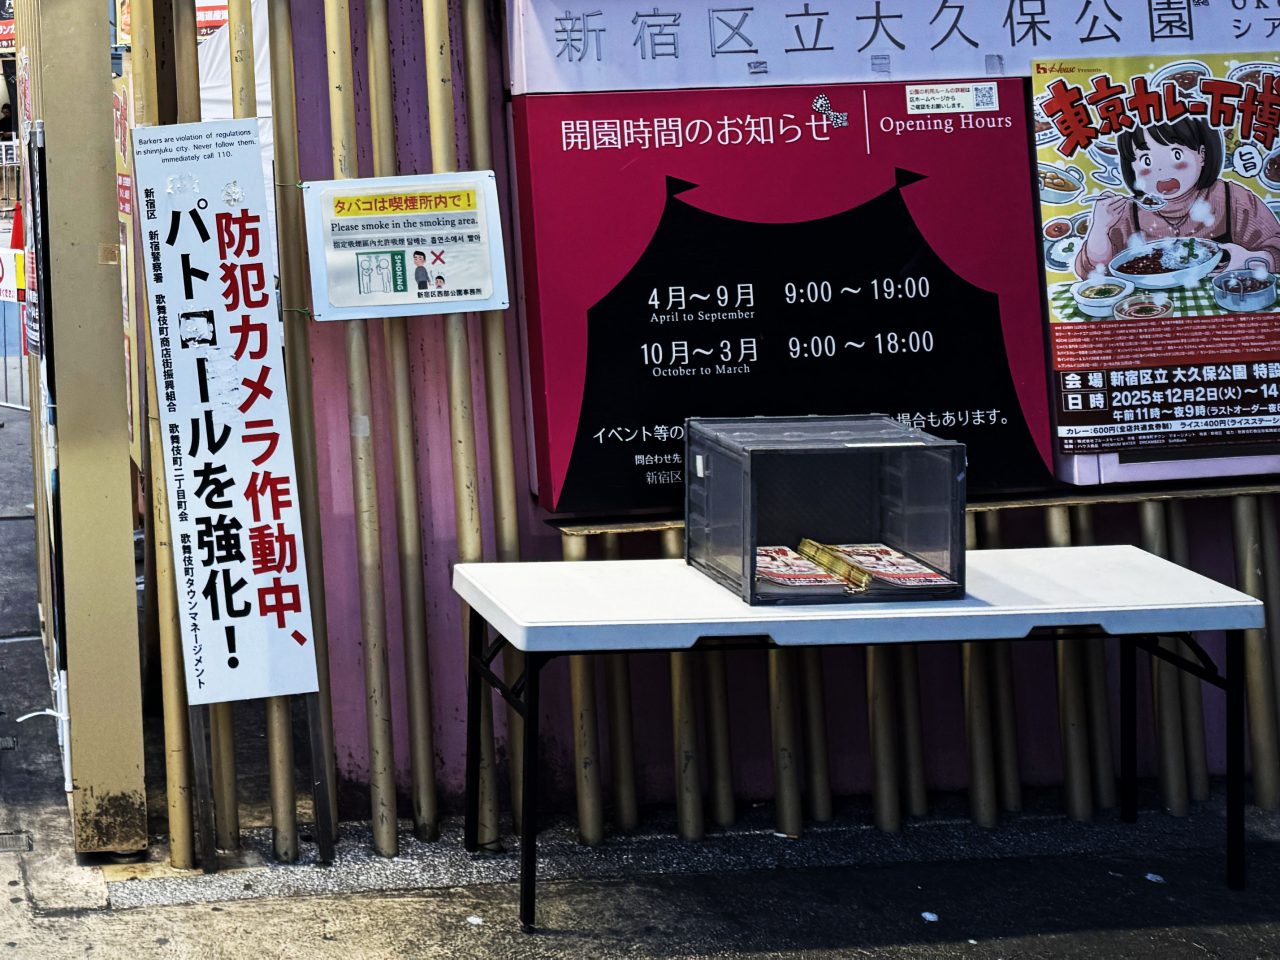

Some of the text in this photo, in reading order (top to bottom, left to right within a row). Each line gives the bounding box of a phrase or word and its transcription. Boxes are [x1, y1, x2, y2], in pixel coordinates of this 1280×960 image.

[880, 113, 1012, 135] Opening Hours
[1038, 73, 1280, 158] 東京カレー万博
[176, 134, 203, 142] violation
[216, 129, 252, 138] regulations
[561, 113, 832, 152] 開園時間のお知らせ
[162, 155, 200, 164] immediately
[144, 188, 157, 220] 新宿区
[334, 193, 472, 214] タバコは喫煙所内で！
[331, 217, 479, 232] Please smoke in the smoking area.
[148, 230, 163, 284] 新宿警察署
[394, 254, 403, 291] SMOKING
[650, 310, 756, 324] April to September
[652, 363, 750, 377] October to March
[215, 208, 308, 646] 防犯カメラ作動中、
[593, 409, 1008, 444] イベント等の 場合もあります。
[169, 423, 189, 522] 歌舞伎町二丁目町会
[634, 453, 682, 465] 問合わせ先
[646, 470, 683, 485] 新宿区
[180, 533, 205, 689] 歌舞伎町タウンマネージメント
